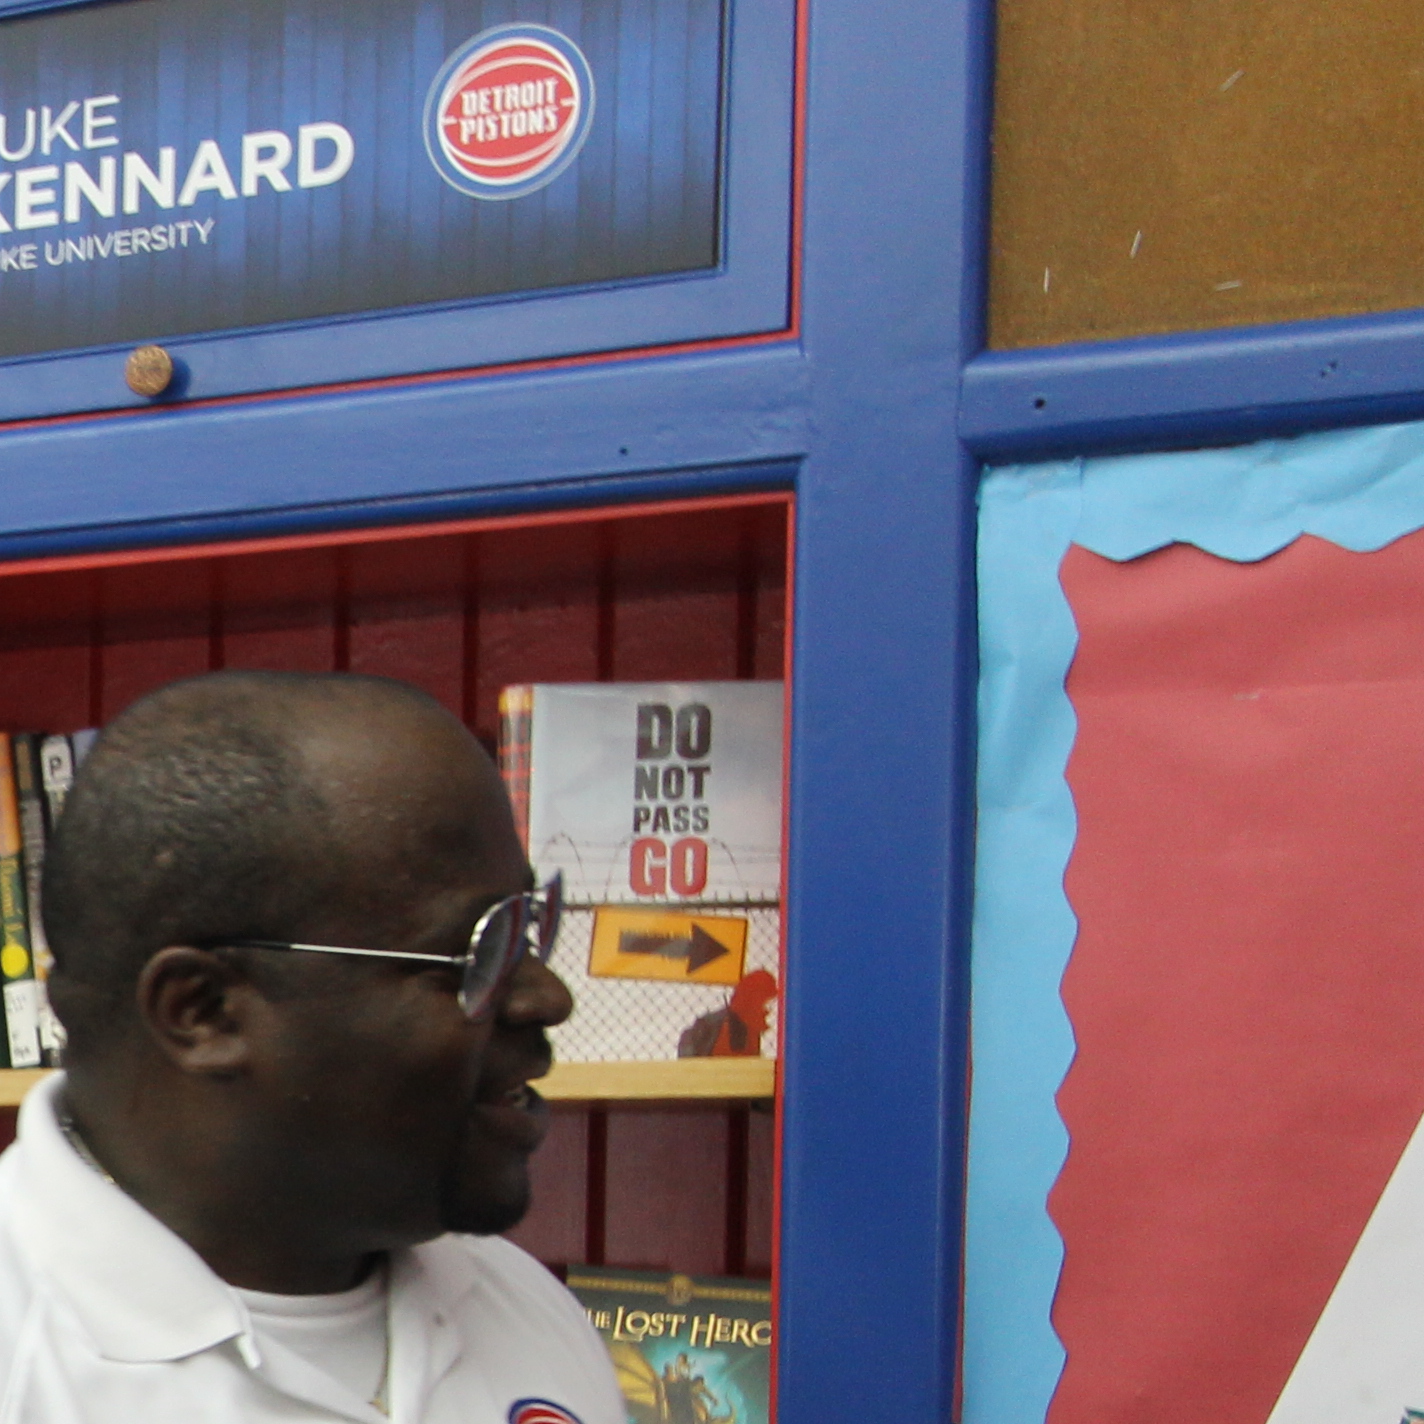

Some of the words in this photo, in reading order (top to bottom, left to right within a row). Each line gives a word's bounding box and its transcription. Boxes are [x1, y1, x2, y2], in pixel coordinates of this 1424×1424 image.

[460, 77, 559, 116] DETROIT
[458, 104, 559, 145] PISTONS
[45, 216, 215, 266] UNIVERSITY
[636, 702, 712, 759] DO
[634, 765, 711, 801] NOT
[633, 805, 709, 834] PASS
[629, 837, 708, 896] GO
[584, 1308, 611, 1329] HE
[613, 1305, 687, 1342] LOST
